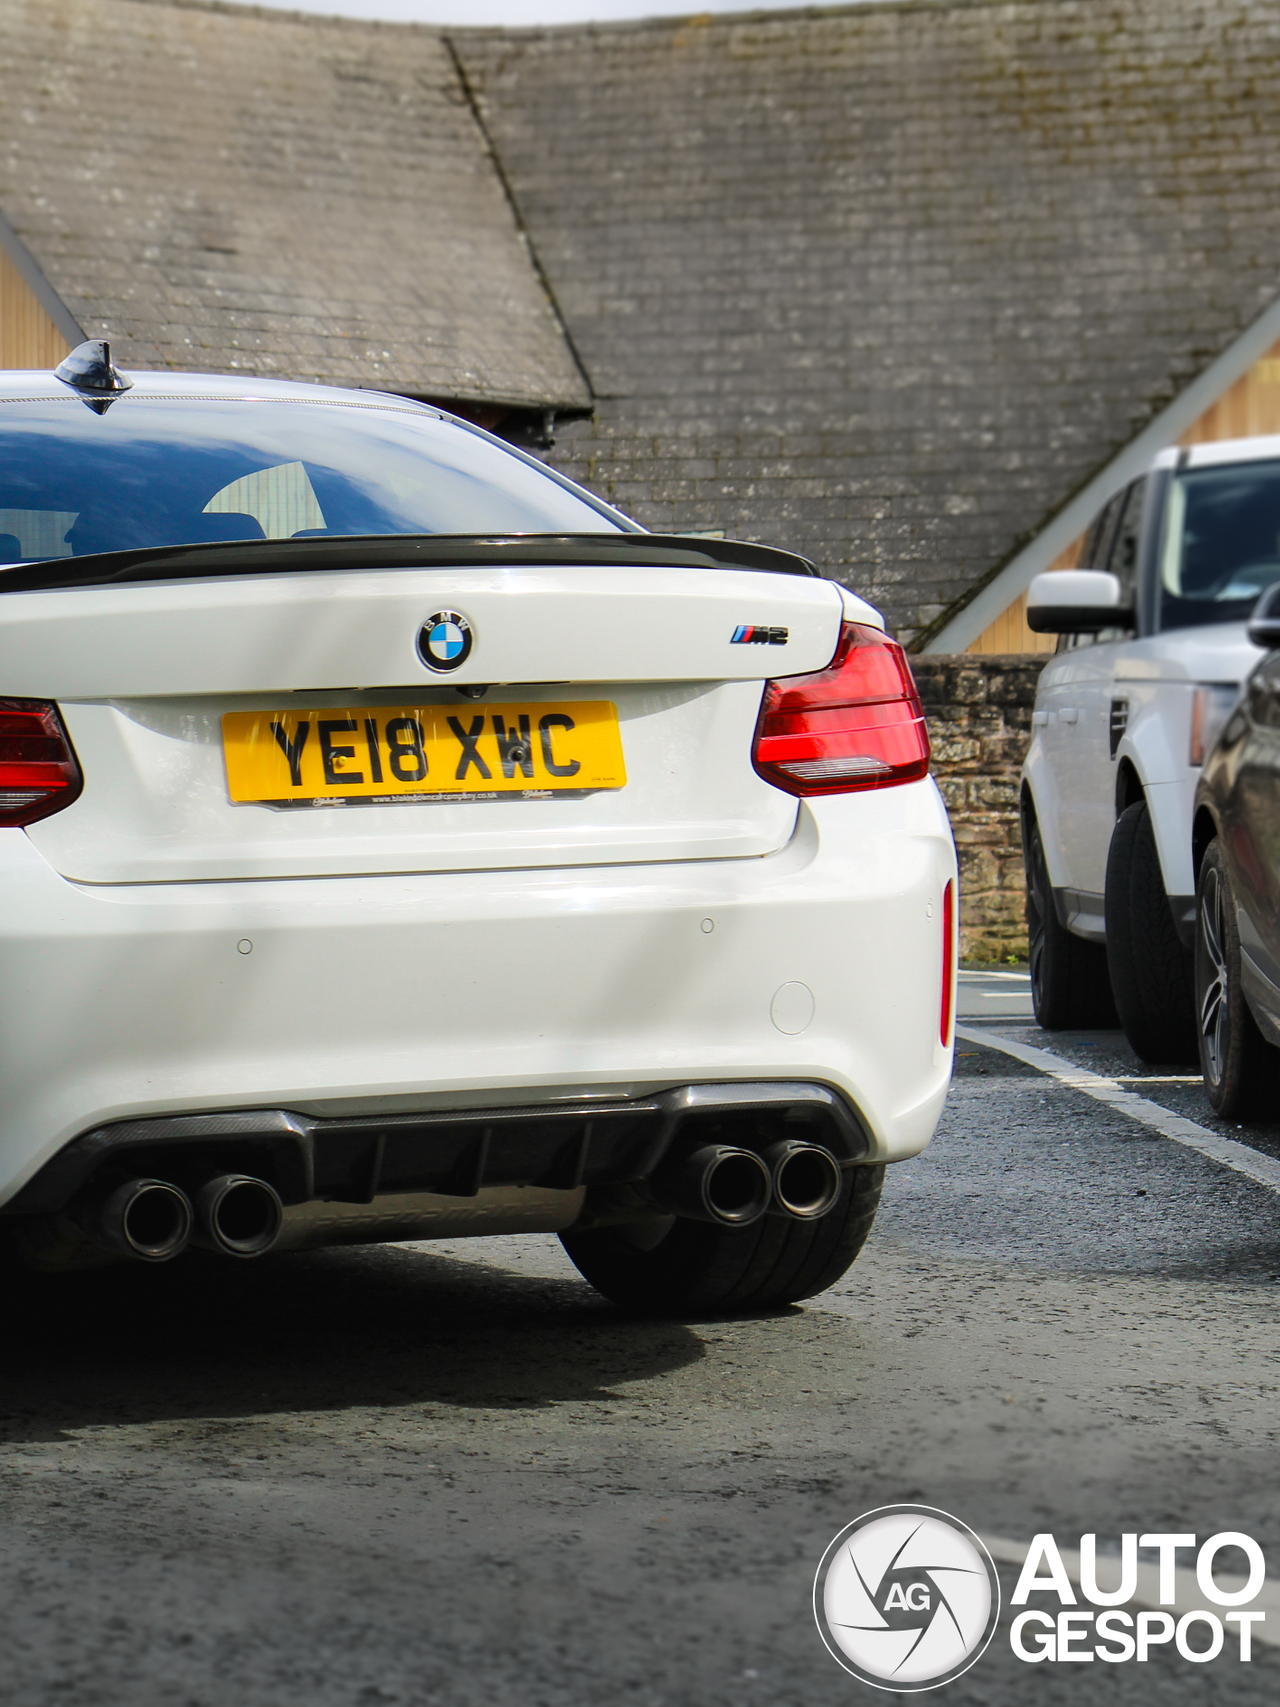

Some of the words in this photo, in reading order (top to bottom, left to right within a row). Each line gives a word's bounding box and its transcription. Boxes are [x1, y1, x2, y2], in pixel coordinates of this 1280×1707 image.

[423, 612, 469, 631] BMW
[748, 624, 790, 646] M2
[270, 717, 429, 787] YE18
[446, 713, 581, 781] XWC
